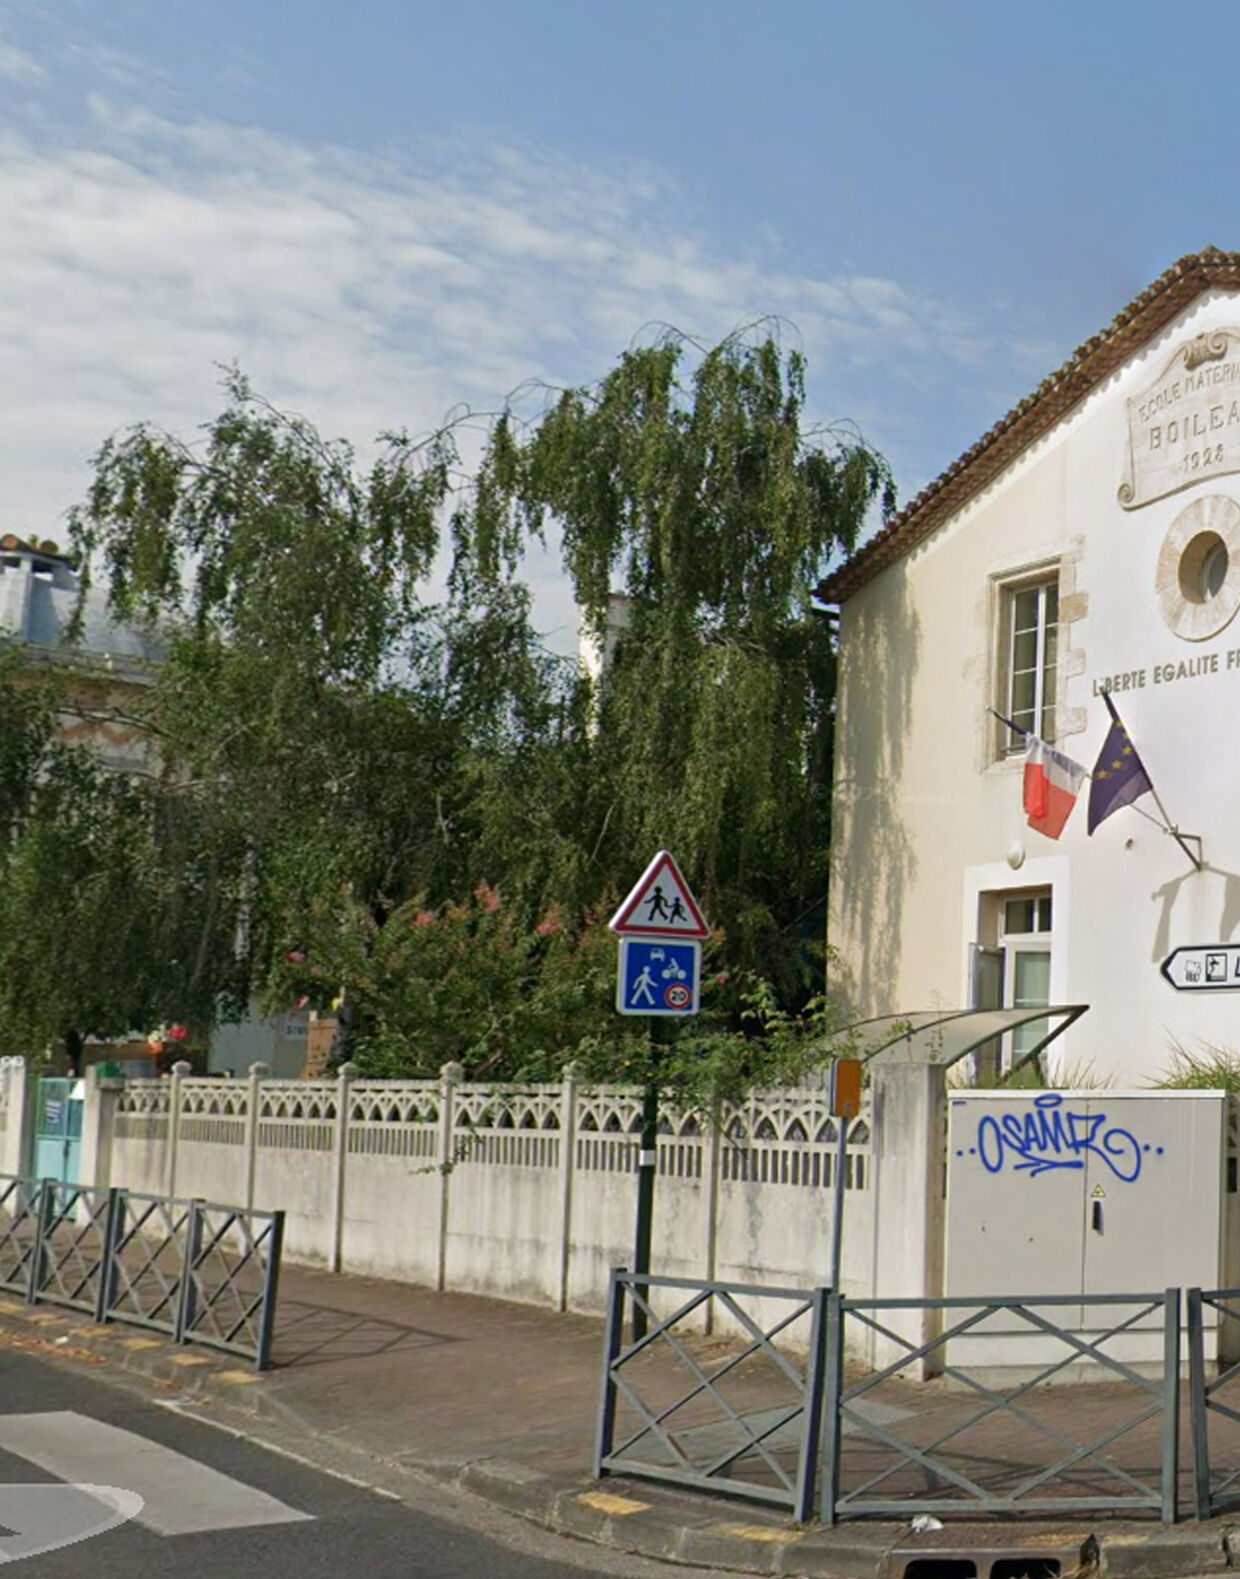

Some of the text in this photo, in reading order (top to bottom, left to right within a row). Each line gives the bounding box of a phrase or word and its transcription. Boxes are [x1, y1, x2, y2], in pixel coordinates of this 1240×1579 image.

[1138, 381, 1181, 422] ECOLE
[1093, 669, 1146, 698] LBERTE
[1154, 653, 1219, 685] EGALITE
[671, 990, 687, 1002] 20
